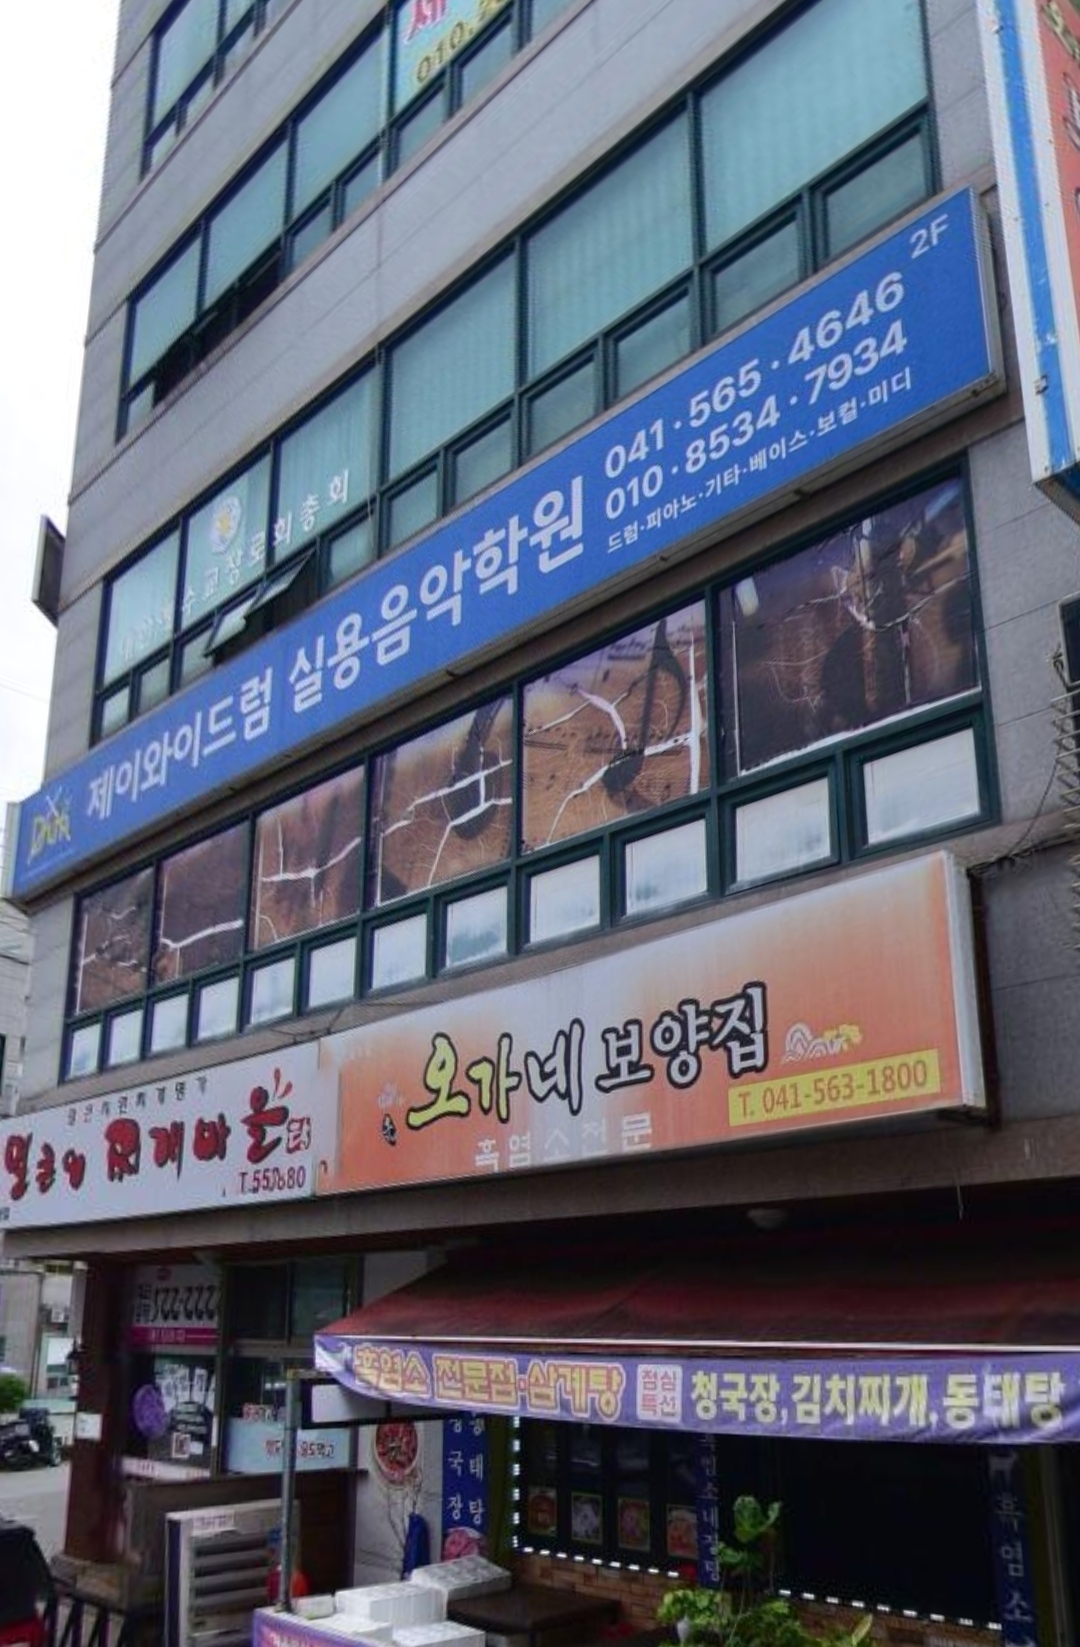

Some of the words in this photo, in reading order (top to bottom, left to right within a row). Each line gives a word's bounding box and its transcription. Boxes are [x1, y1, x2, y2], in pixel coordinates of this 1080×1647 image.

[909, 214, 951, 260] 2F
[86, 668, 273, 819] 제이와이드럼
[288, 476, 585, 714] 실용음악학원
[406, 1017, 585, 1130] 오가네
[595, 980, 769, 1094] 보양집
[762, 1059, 929, 1116] 041-563-1800
